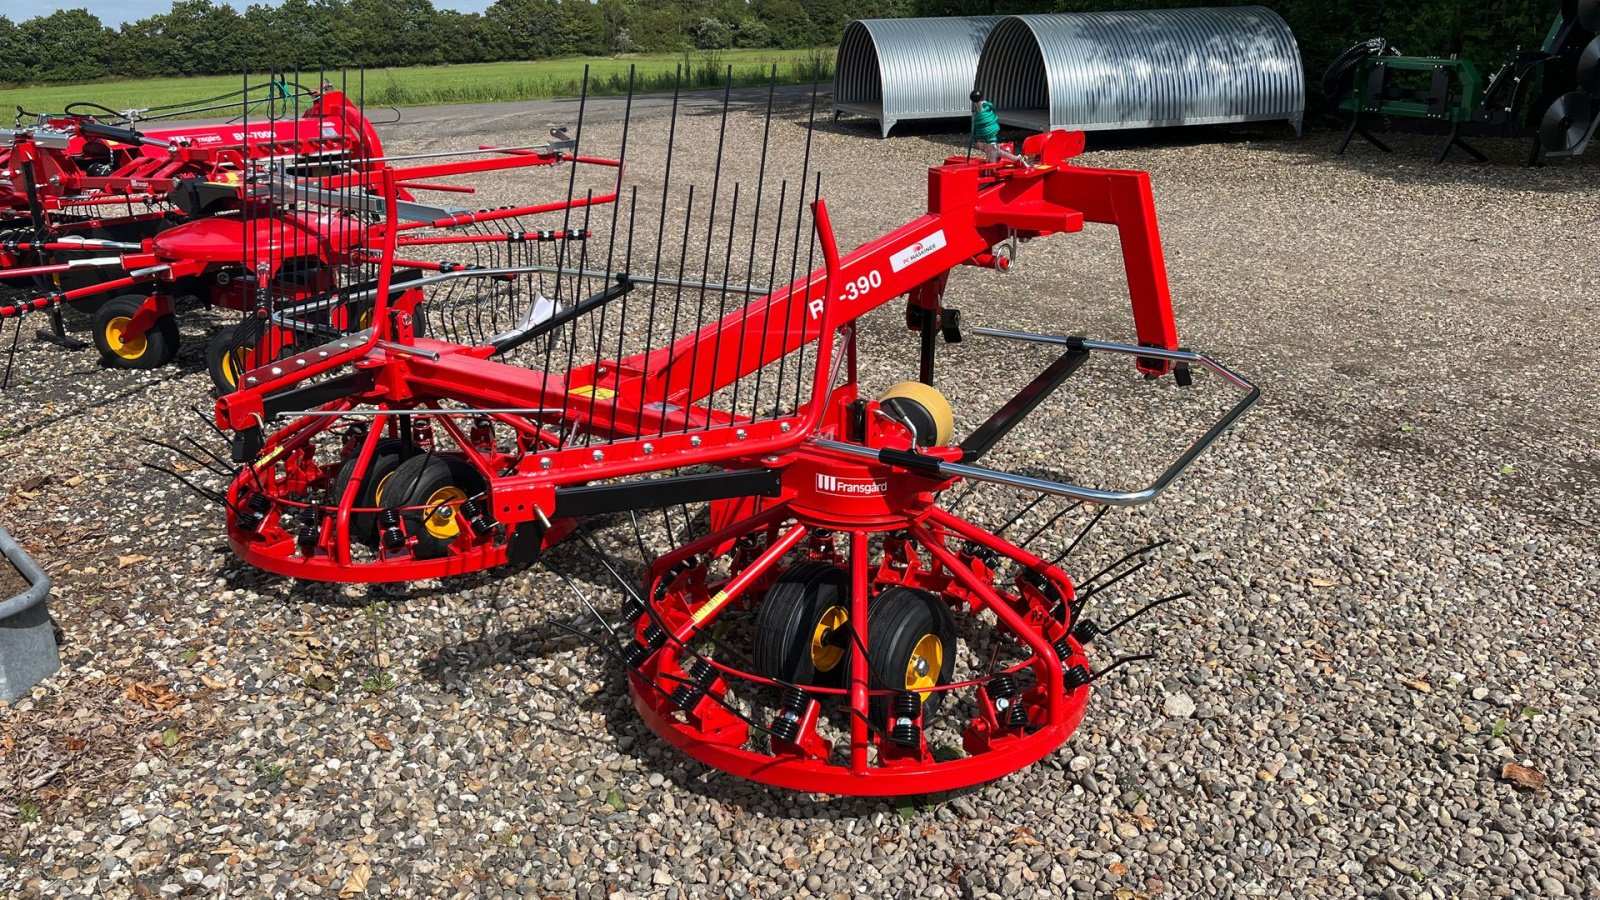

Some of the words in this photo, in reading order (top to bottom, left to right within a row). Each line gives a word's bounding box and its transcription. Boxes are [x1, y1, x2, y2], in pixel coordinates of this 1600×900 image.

[910, 243, 936, 261] MASKINER
[809, 269, 882, 320] R-390
[837, 482, 887, 494] Fransgård
